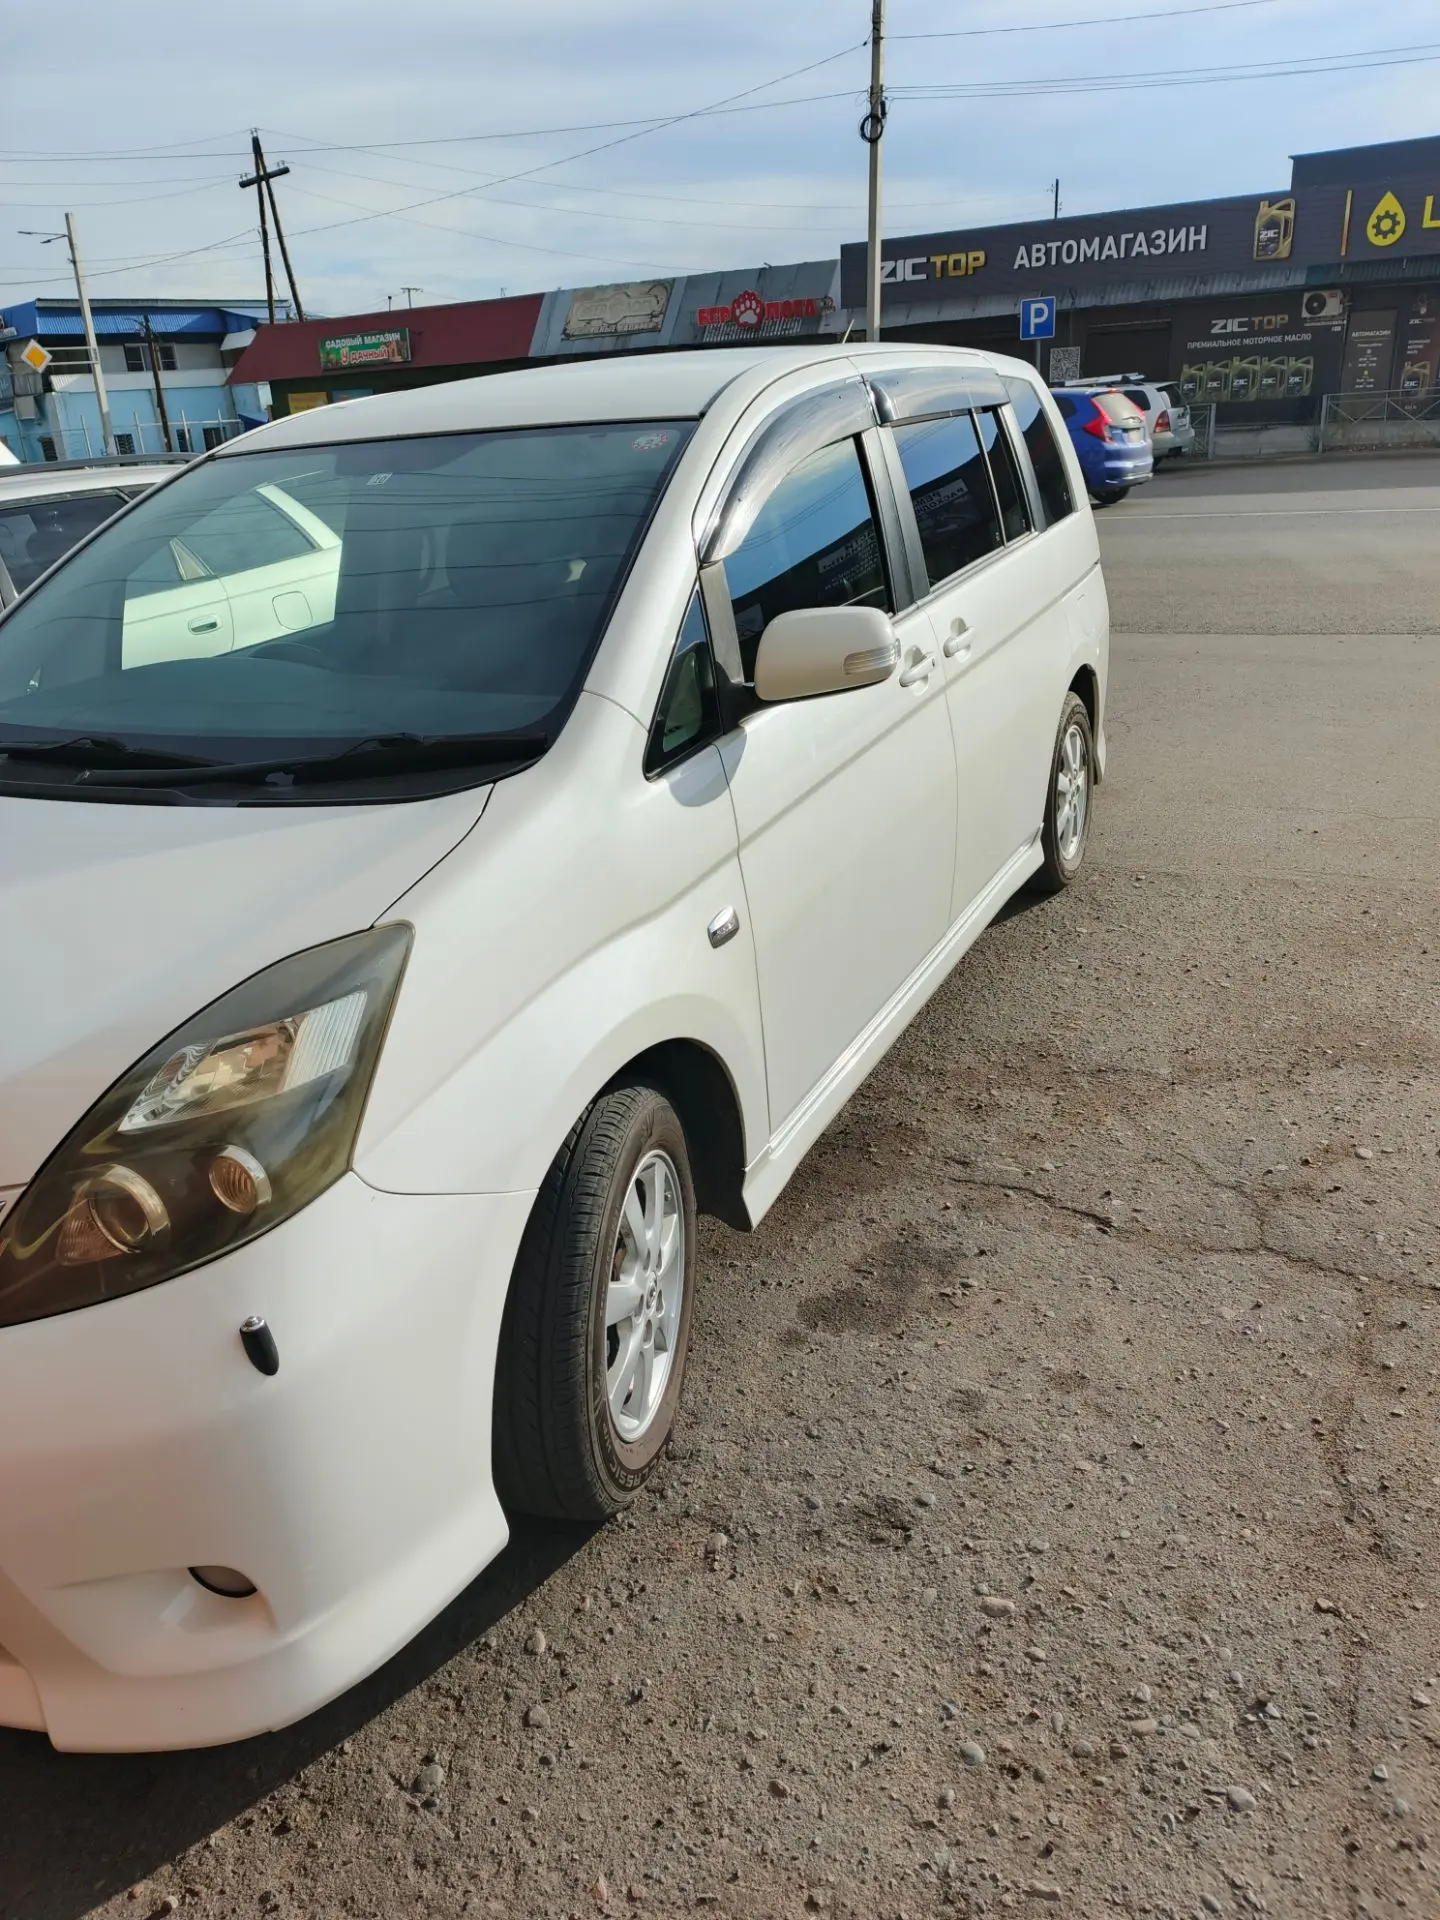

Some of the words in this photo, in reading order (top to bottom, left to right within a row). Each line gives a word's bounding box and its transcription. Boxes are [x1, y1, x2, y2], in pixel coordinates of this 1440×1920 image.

[1260, 229, 1278, 238] ZIC
[1013, 225, 1207, 269] АВТОМАГАЗИН
[930, 251, 985, 279] TOP
[1030, 303, 1048, 334] P
[1210, 317, 1249, 334] ZIC
[1251, 314, 1289, 330] TOP
[325, 335, 363, 348] САДОВЫЙ
[364, 333, 400, 344] МАГАЗИН
[1187, 339, 1241, 349] ПРЕМИАЛЬНОЕ
[1243, 335, 1283, 345] МОТОРНОЕ
[1284, 333, 1312, 343] МАСЛО
[609, 1456, 657, 1488] CLASSIC
